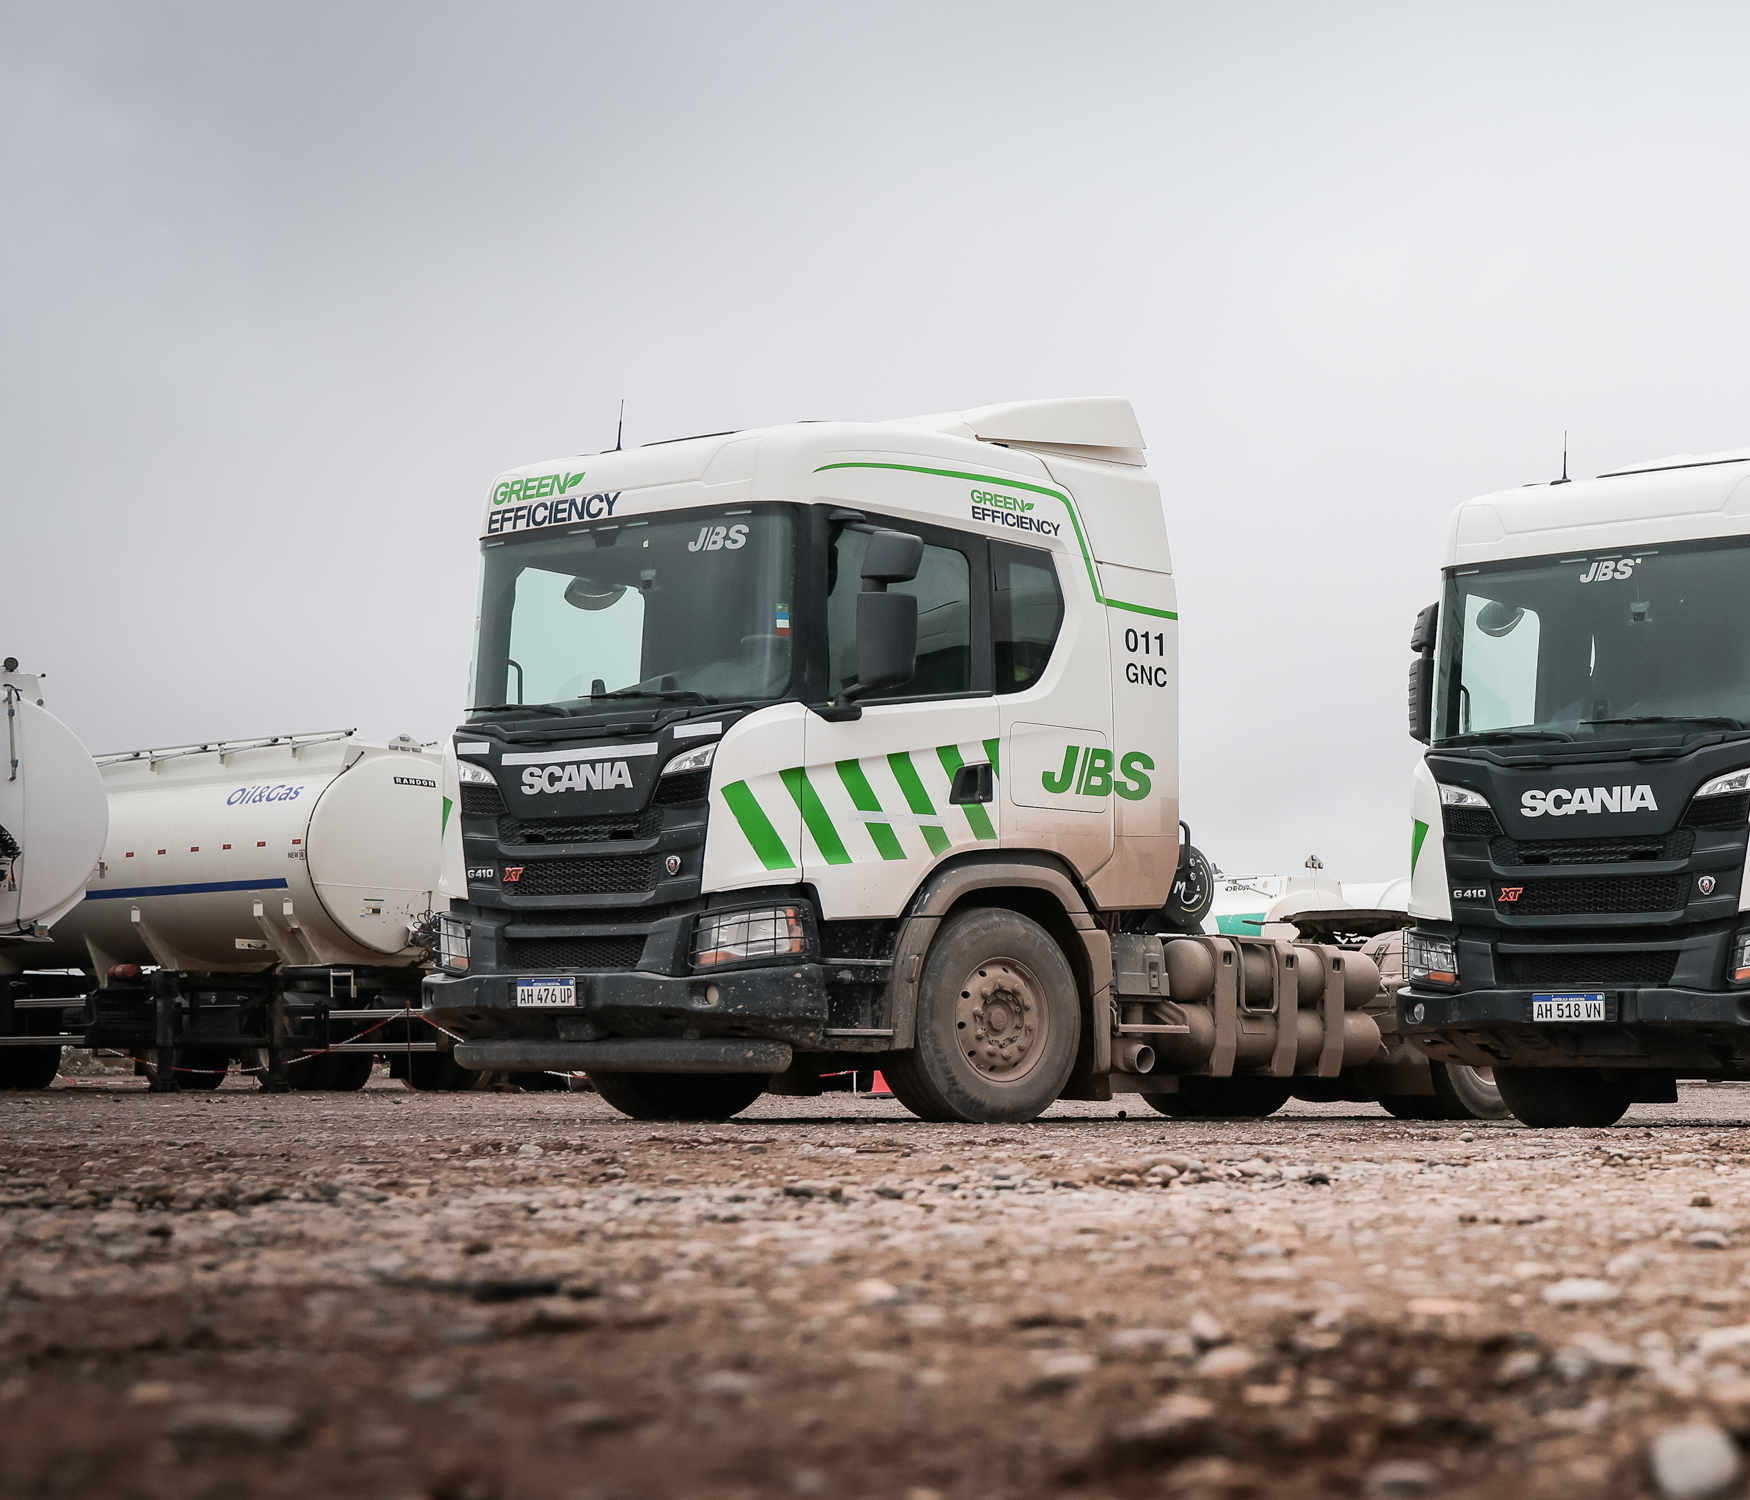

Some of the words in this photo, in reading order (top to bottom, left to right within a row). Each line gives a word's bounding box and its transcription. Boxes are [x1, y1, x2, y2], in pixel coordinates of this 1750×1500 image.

[493, 473, 571, 505] GREEN
[970, 489, 1025, 513] GREEN
[487, 492, 622, 534] EFFICIENCY
[971, 505, 1061, 537] EFFICIENCY
[687, 523, 750, 553] JBS
[1579, 558, 1635, 584] JBS
[1124, 628, 1165, 657] 011
[1125, 662, 1168, 688] GNC
[395, 776, 435, 787] RANDON
[520, 760, 634, 795] SCANIA
[1041, 744, 1156, 802] JBS
[226, 784, 305, 806] Oil&Gas
[1519, 784, 1659, 818] SCANIA
[502, 867, 524, 882] XT
[1497, 886, 1524, 902] XT
[520, 988, 534, 1004] AH
[537, 988, 557, 1004] 476
[560, 987, 573, 1004] UP
[1536, 1003, 1553, 1019] AH
[1556, 1002, 1581, 1018] 518
[1585, 1002, 1602, 1018] VN
